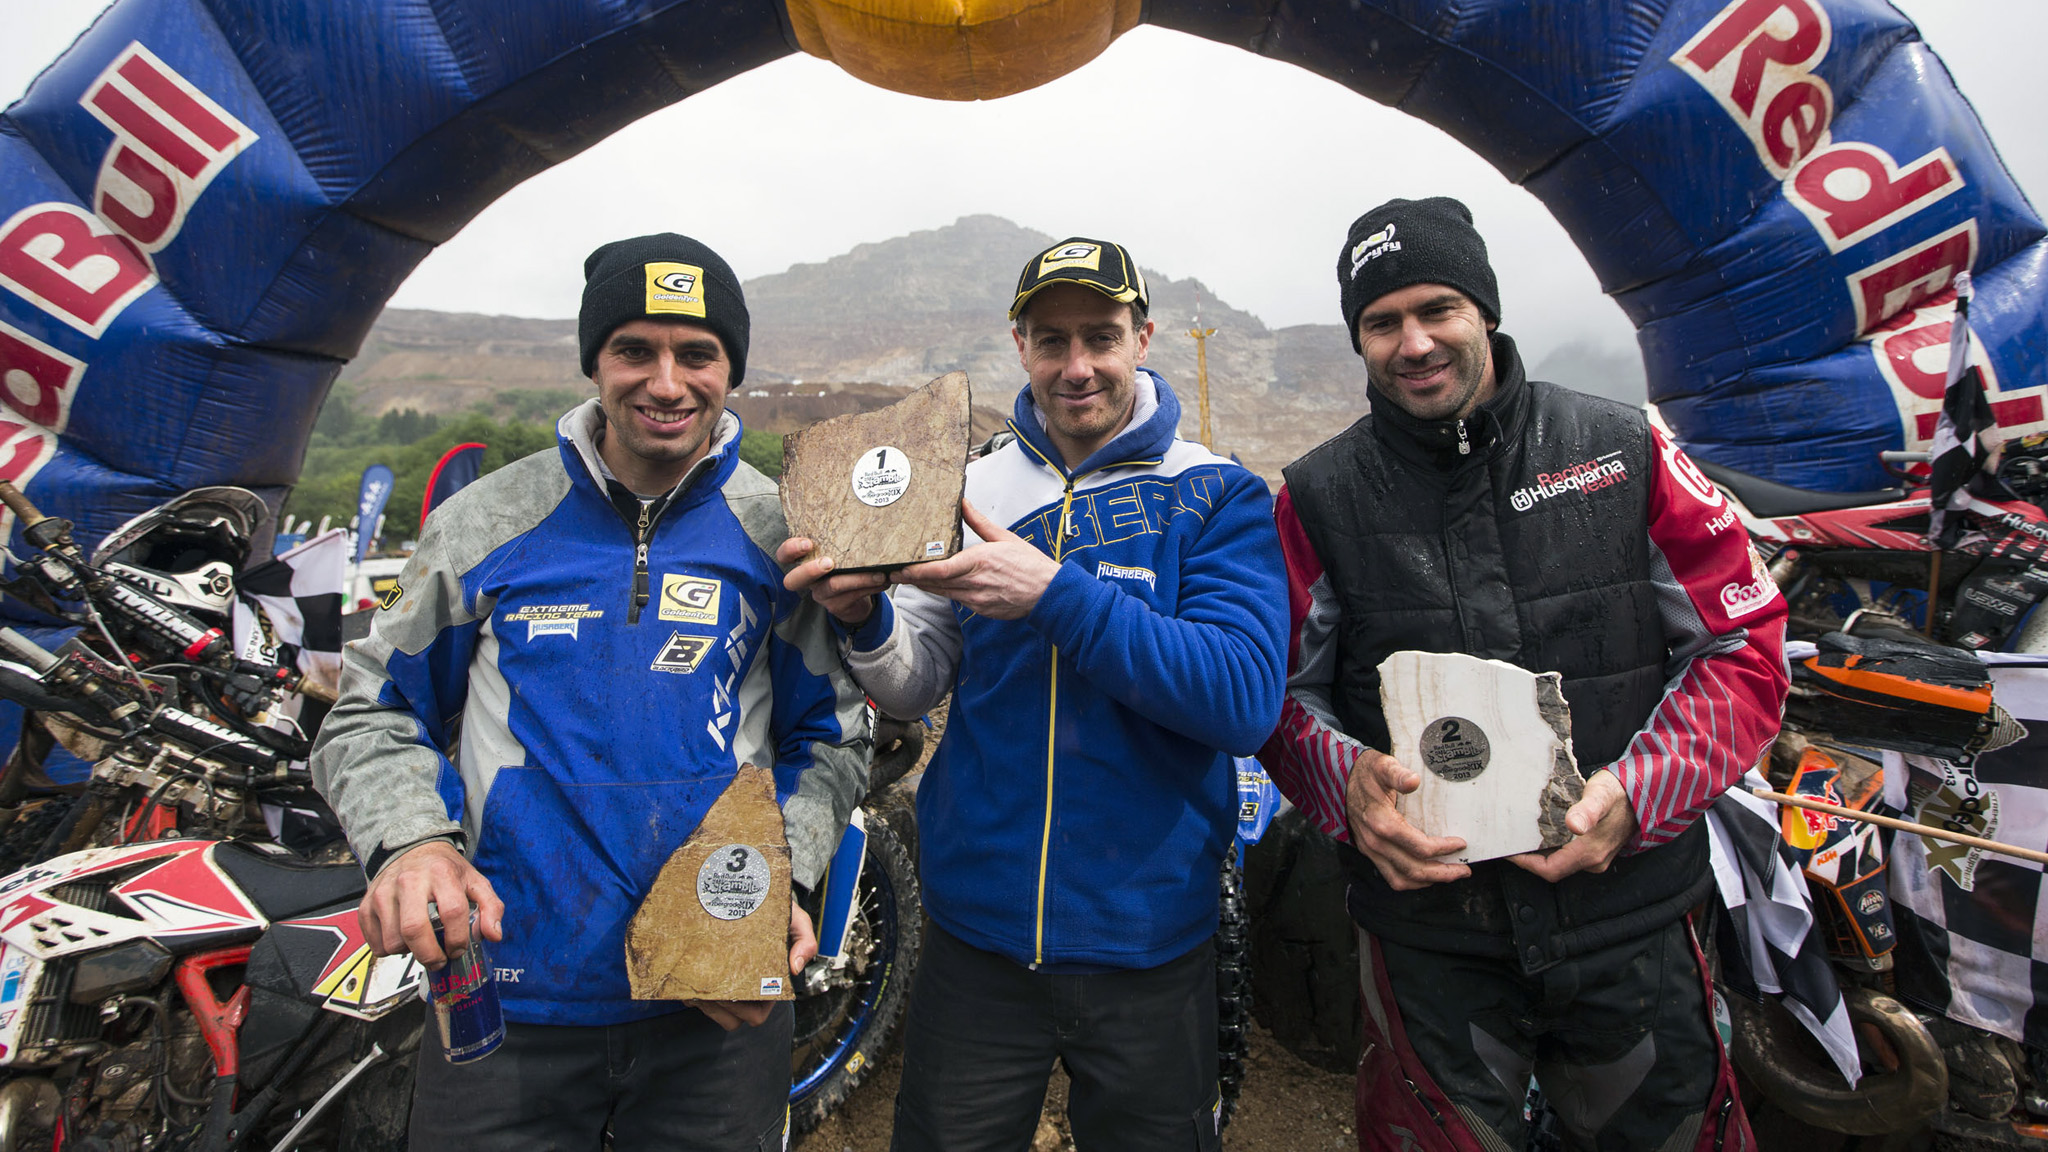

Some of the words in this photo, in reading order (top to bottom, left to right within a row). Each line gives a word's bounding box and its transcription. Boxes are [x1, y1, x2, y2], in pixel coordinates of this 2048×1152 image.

[1680, 0, 1960, 246] Red
[0, 48, 250, 333] Bull
[876, 449, 887, 470] 1
[1528, 459, 1627, 503] Husqvarna
[1579, 470, 1628, 495] Team
[874, 496, 890, 504] 2013
[1096, 562, 1157, 593] HUSABERG
[504, 612, 562, 622] RACING
[565, 610, 605, 620] TEAM
[519, 603, 591, 614] EXTREME
[660, 607, 716, 621] GoldenTyre
[532, 623, 576, 636] HUSABERG
[1441, 720, 1461, 744] 2
[1453, 771, 1471, 779] 2013
[726, 848, 749, 872] 3
[1816, 850, 1838, 866] KTM
[1963, 851, 1981, 891] SUPREME
[728, 909, 747, 917] 2013
[449, 961, 483, 991] Bull
